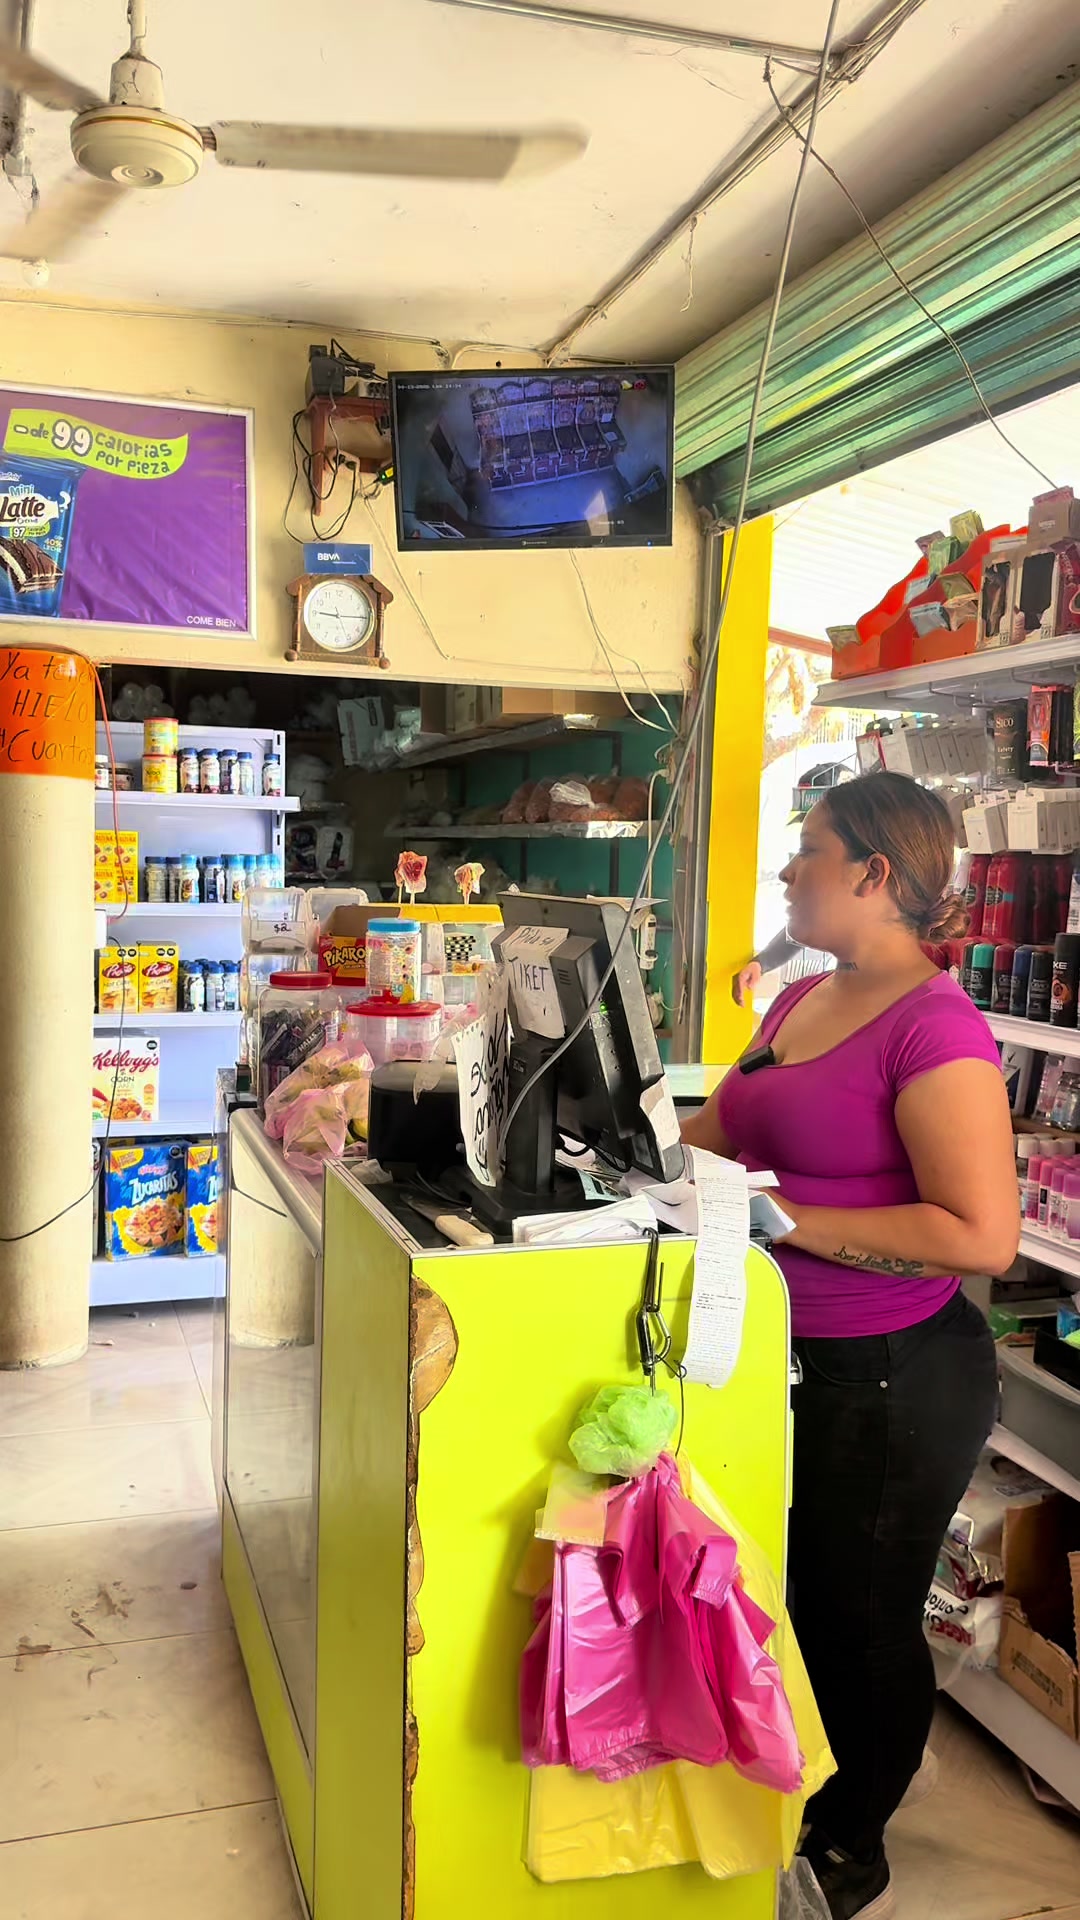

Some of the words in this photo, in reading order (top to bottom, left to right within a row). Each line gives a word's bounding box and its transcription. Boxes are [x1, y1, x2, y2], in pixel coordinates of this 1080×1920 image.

[52, 419, 94, 457] 99
[9, 484, 35, 497] Mini
[0, 496, 45, 523] Latte
[13, 527, 26, 538] 97
[317, 552, 340, 561] BBVA
[186, 615, 214, 626] COME
[215, 617, 237, 628] BIEN
[0, 651, 30, 681] Ya
[273, 922, 292, 934] $2
[323, 945, 367, 967] PiKARO
[508, 956, 549, 991] TIKET
[92, 1049, 159, 1073] Kellogg's
[128, 1171, 178, 1206] ZUCARITAS
